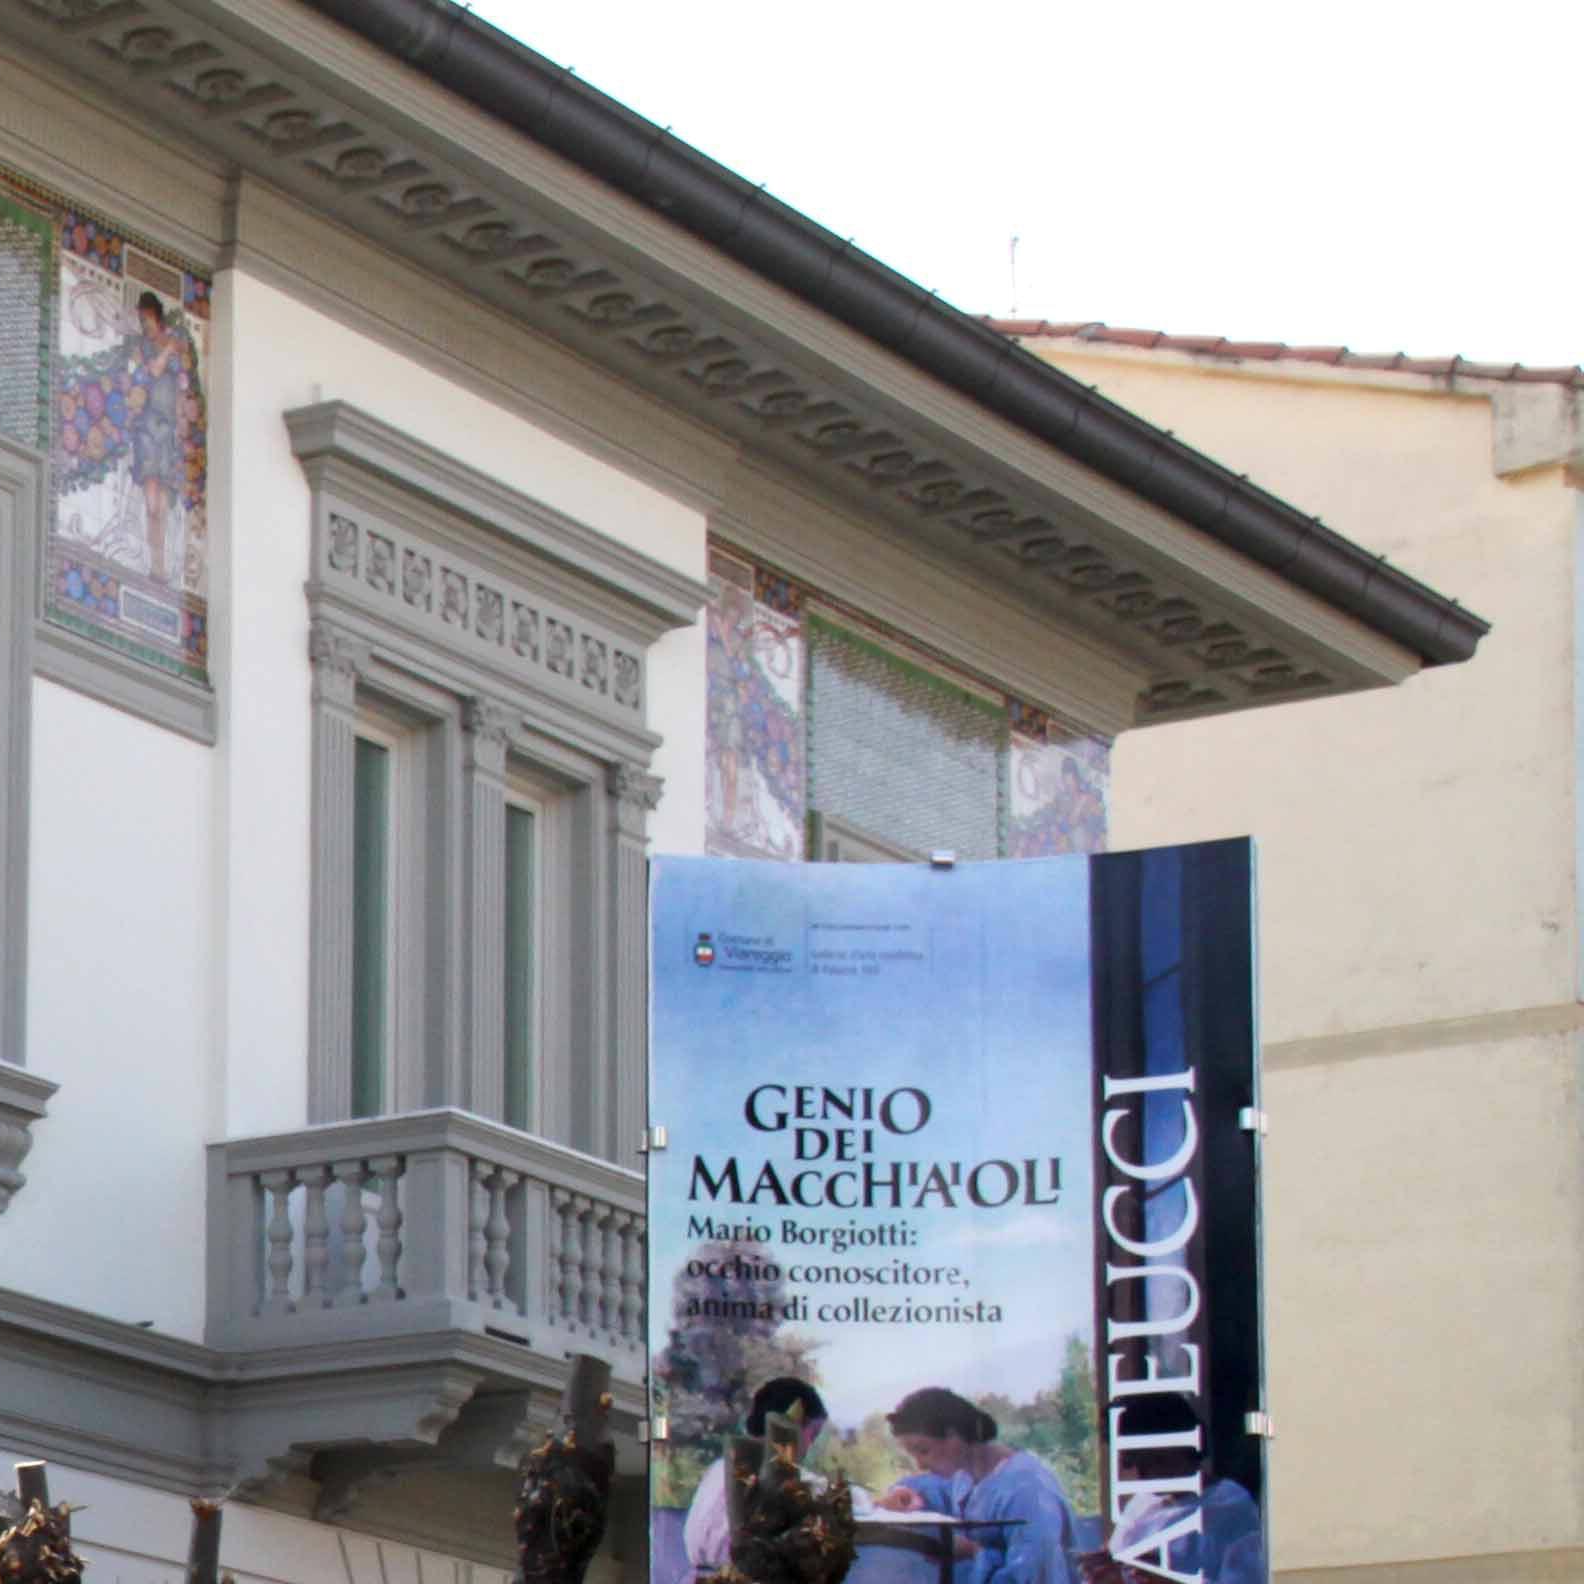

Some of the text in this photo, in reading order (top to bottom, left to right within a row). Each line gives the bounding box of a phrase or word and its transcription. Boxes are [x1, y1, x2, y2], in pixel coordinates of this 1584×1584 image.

[744, 1083, 932, 1136] GENIO
[793, 1127, 874, 1162] DEI
[687, 1154, 1062, 1209] MACCHIAIOLI
[687, 1215, 918, 1252] Mario Borgiotti:
[686, 1255, 970, 1288] occhio conoscitore,
[686, 1294, 1003, 1324] anima di collezionista
